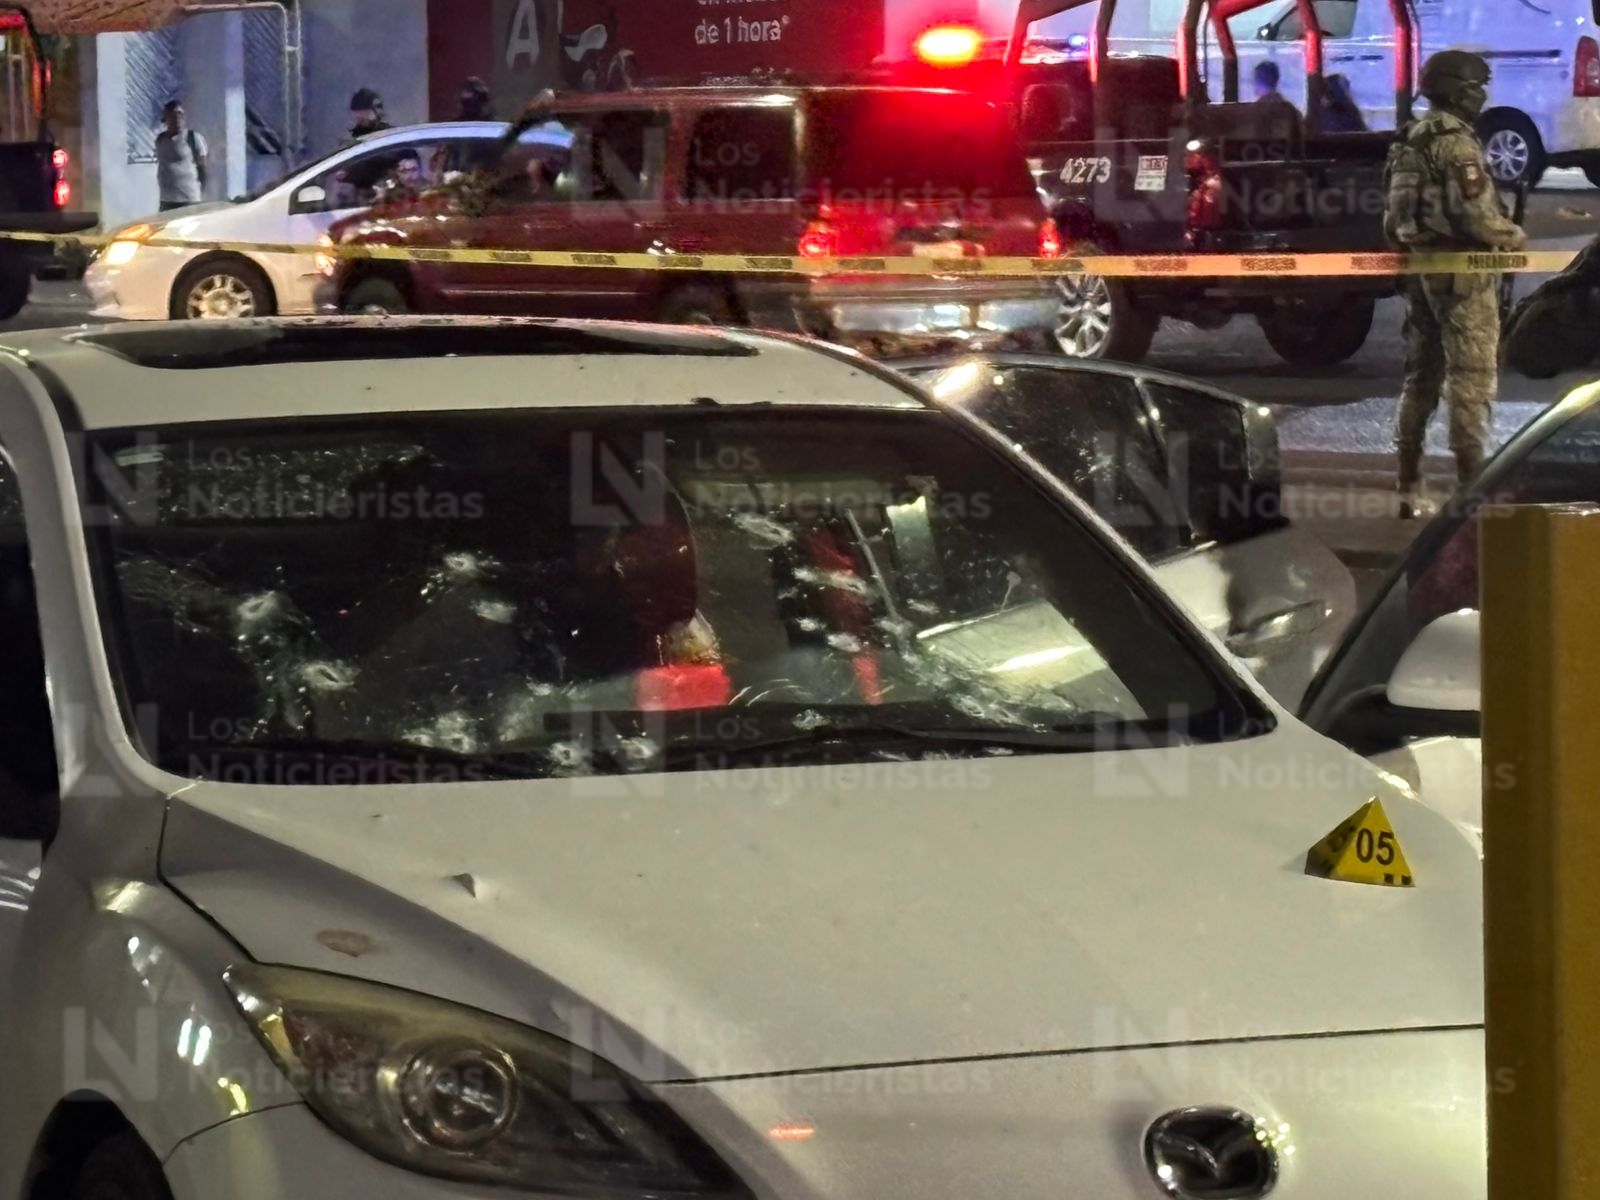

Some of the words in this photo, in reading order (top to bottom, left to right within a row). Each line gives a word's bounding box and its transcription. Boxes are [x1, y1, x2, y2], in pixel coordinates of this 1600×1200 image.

[695, 18, 720, 45] de
[724, 16, 732, 44] 1
[1060, 156, 1112, 184] 4273
[1356, 828, 1395, 866] 05
